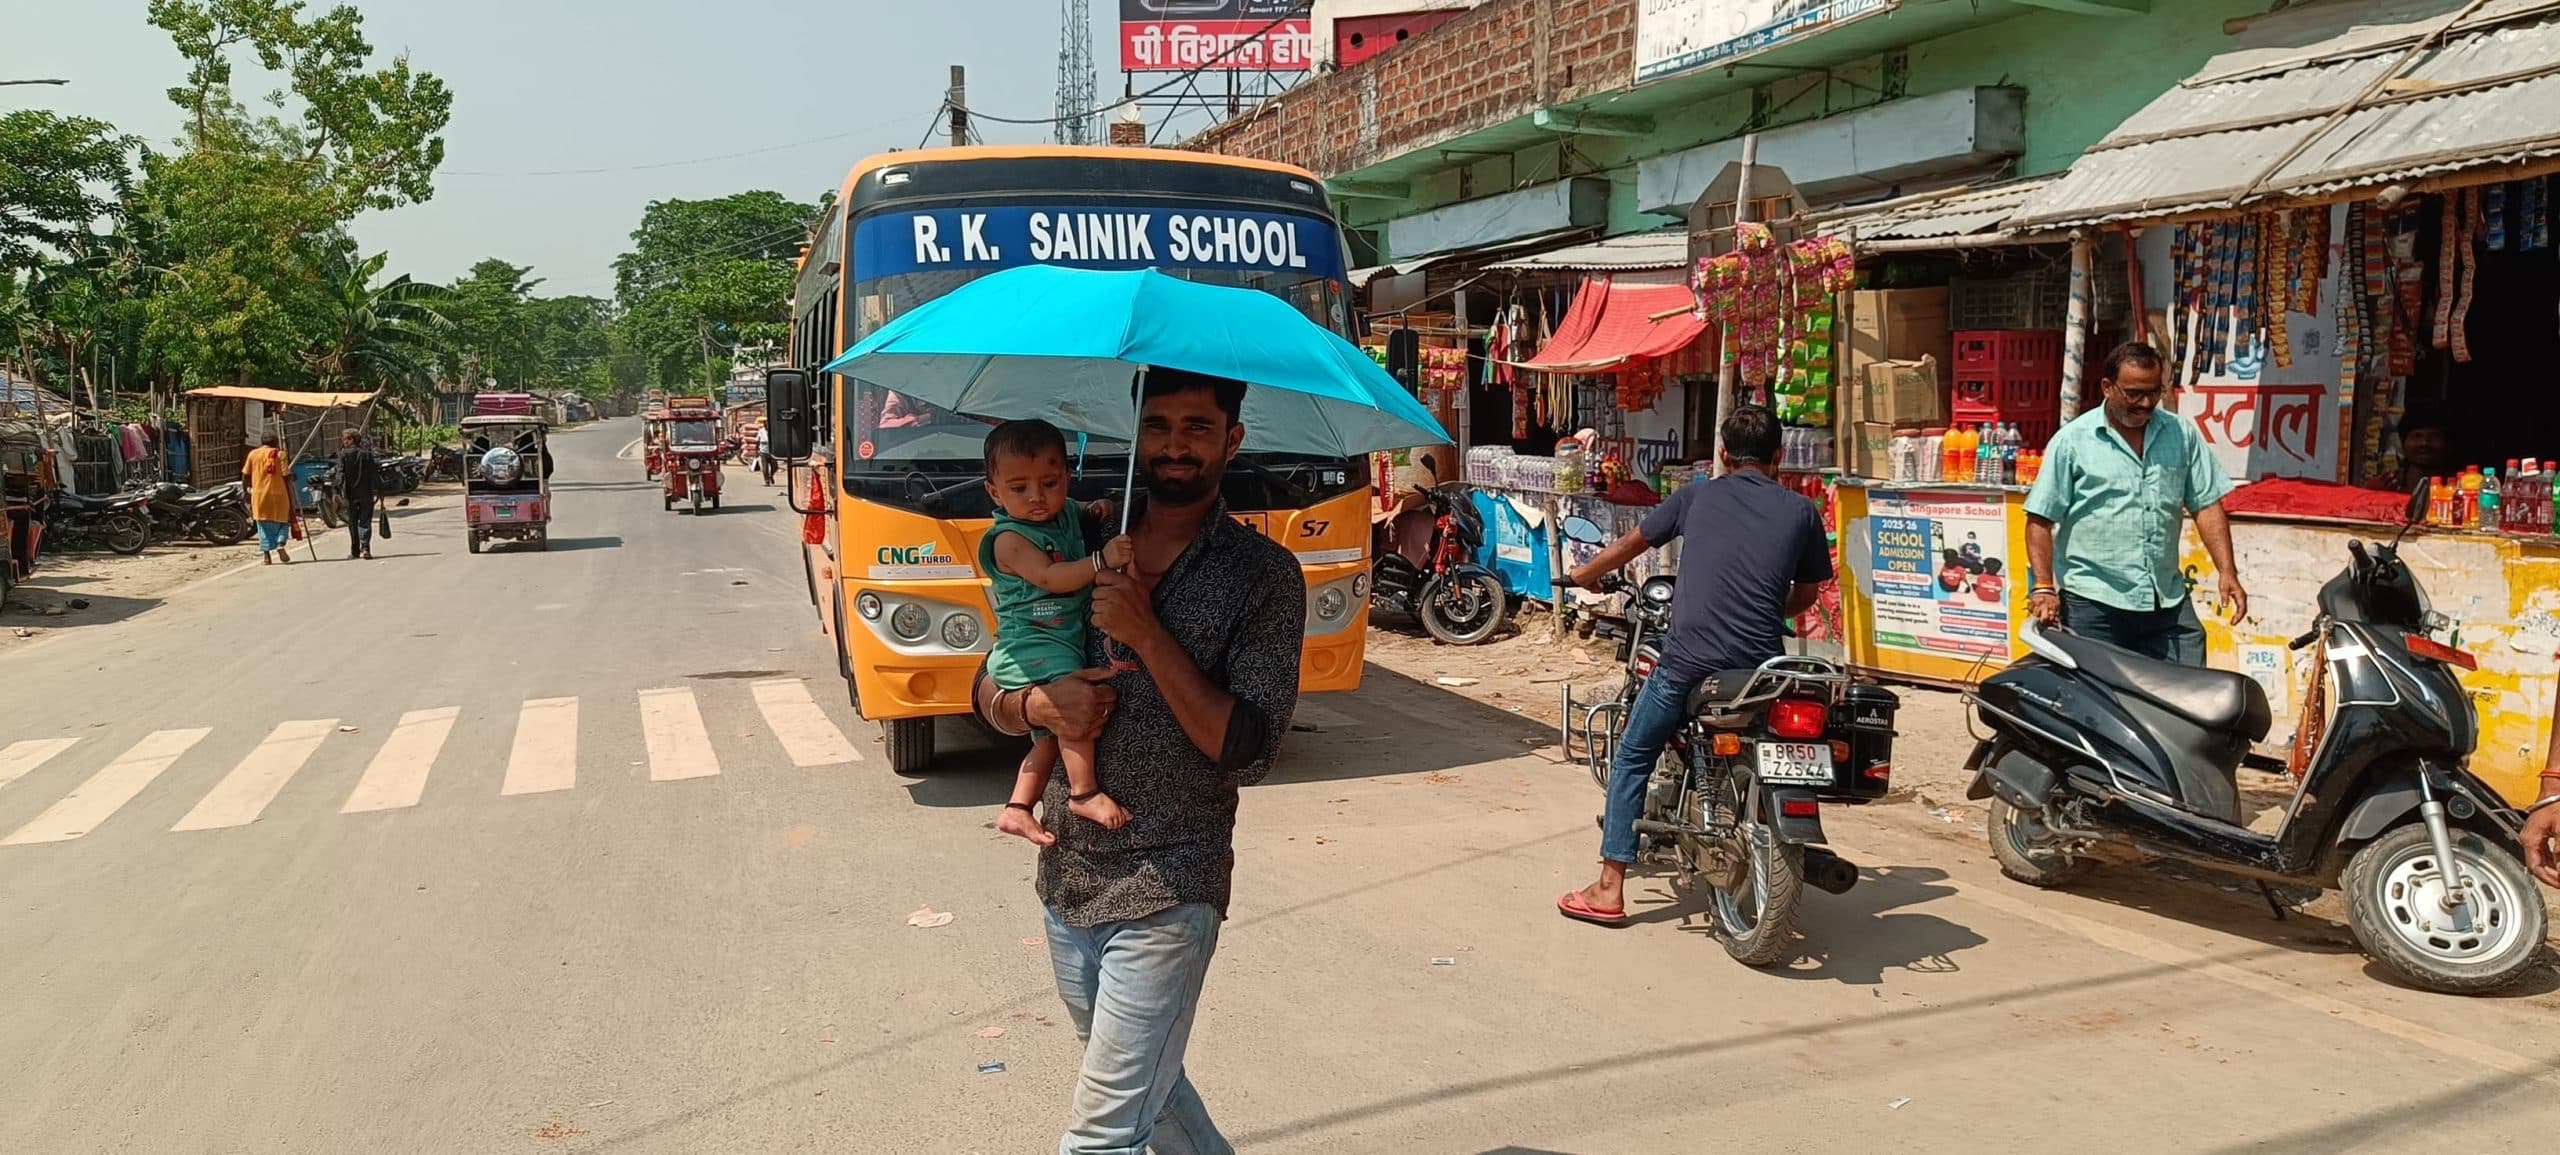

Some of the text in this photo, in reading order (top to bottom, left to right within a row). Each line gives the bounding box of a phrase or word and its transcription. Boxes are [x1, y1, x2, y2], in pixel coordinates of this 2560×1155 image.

[1131, 25, 1164, 64] पी
[1168, 24, 1266, 64] विशाल
[913, 211, 1307, 268] R. K. SAINIK SCHOOL
[2193, 384, 2328, 463] स्टाल
[1910, 504, 1961, 516] Singapore
[1964, 505, 2001, 517] School
[1299, 519, 1330, 538] S7
[1882, 519, 1917, 530] 2025-26
[1878, 531, 1925, 547] SCHOOL
[877, 547, 952, 565] CNG TURBO
[1879, 548, 1925, 560] ADMISSION
[1888, 560, 1916, 572] OPEN
[1856, 716, 1889, 726] AEROSTAR
[1775, 744, 1817, 760] BR50
[1773, 761, 1825, 778] Z2544
